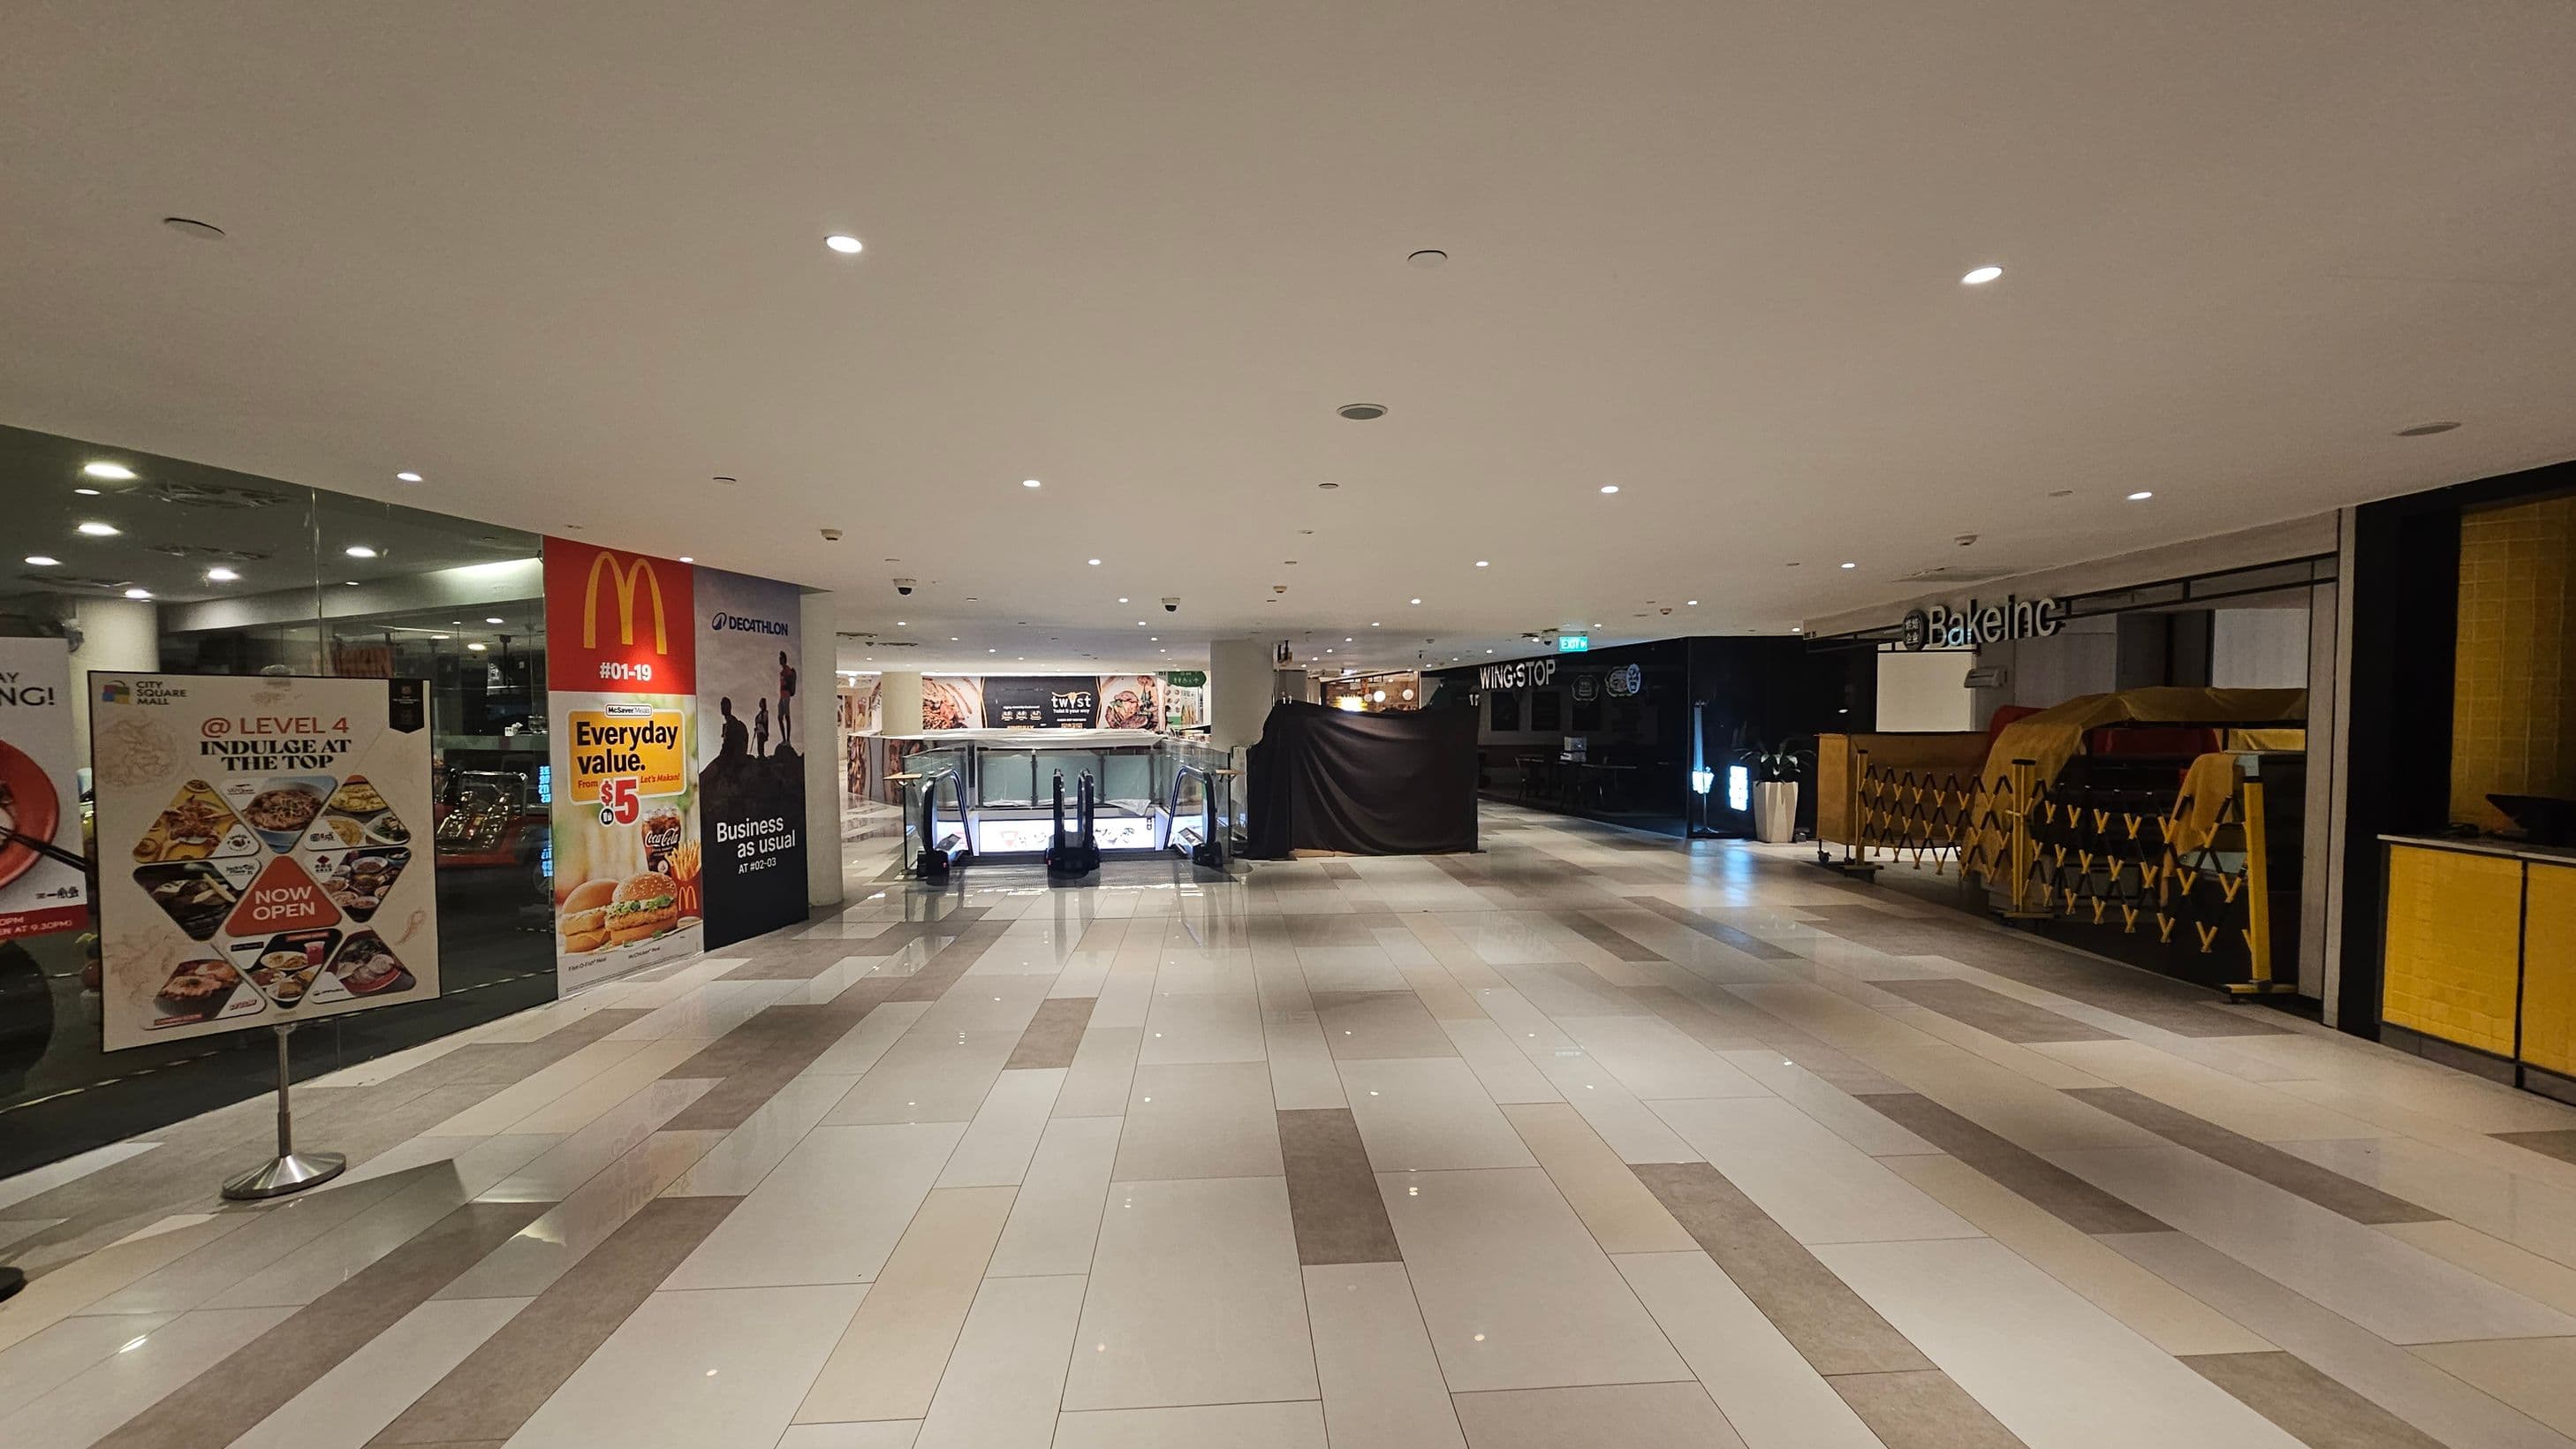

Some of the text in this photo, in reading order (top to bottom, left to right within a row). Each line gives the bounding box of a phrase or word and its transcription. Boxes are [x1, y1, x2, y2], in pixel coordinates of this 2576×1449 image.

[729, 616, 788, 636] DECATHLON
[1561, 637, 1580, 650] EXIT
[600, 662, 652, 681] #01-19
[201, 717, 349, 738] @ LEVEL 4
[576, 720, 678, 751] Everyday
[200, 739, 352, 755] INDULGE AT
[221, 755, 335, 771] THE TOP
[577, 748, 646, 775] value.
[578, 780, 598, 789] From
[601, 779, 640, 825] $5
[716, 817, 784, 843] Business
[737, 830, 795, 859] as usual
[739, 857, 777, 875] AT #02-03
[254, 886, 313, 904] NOW
[253, 902, 315, 921] OPEN
